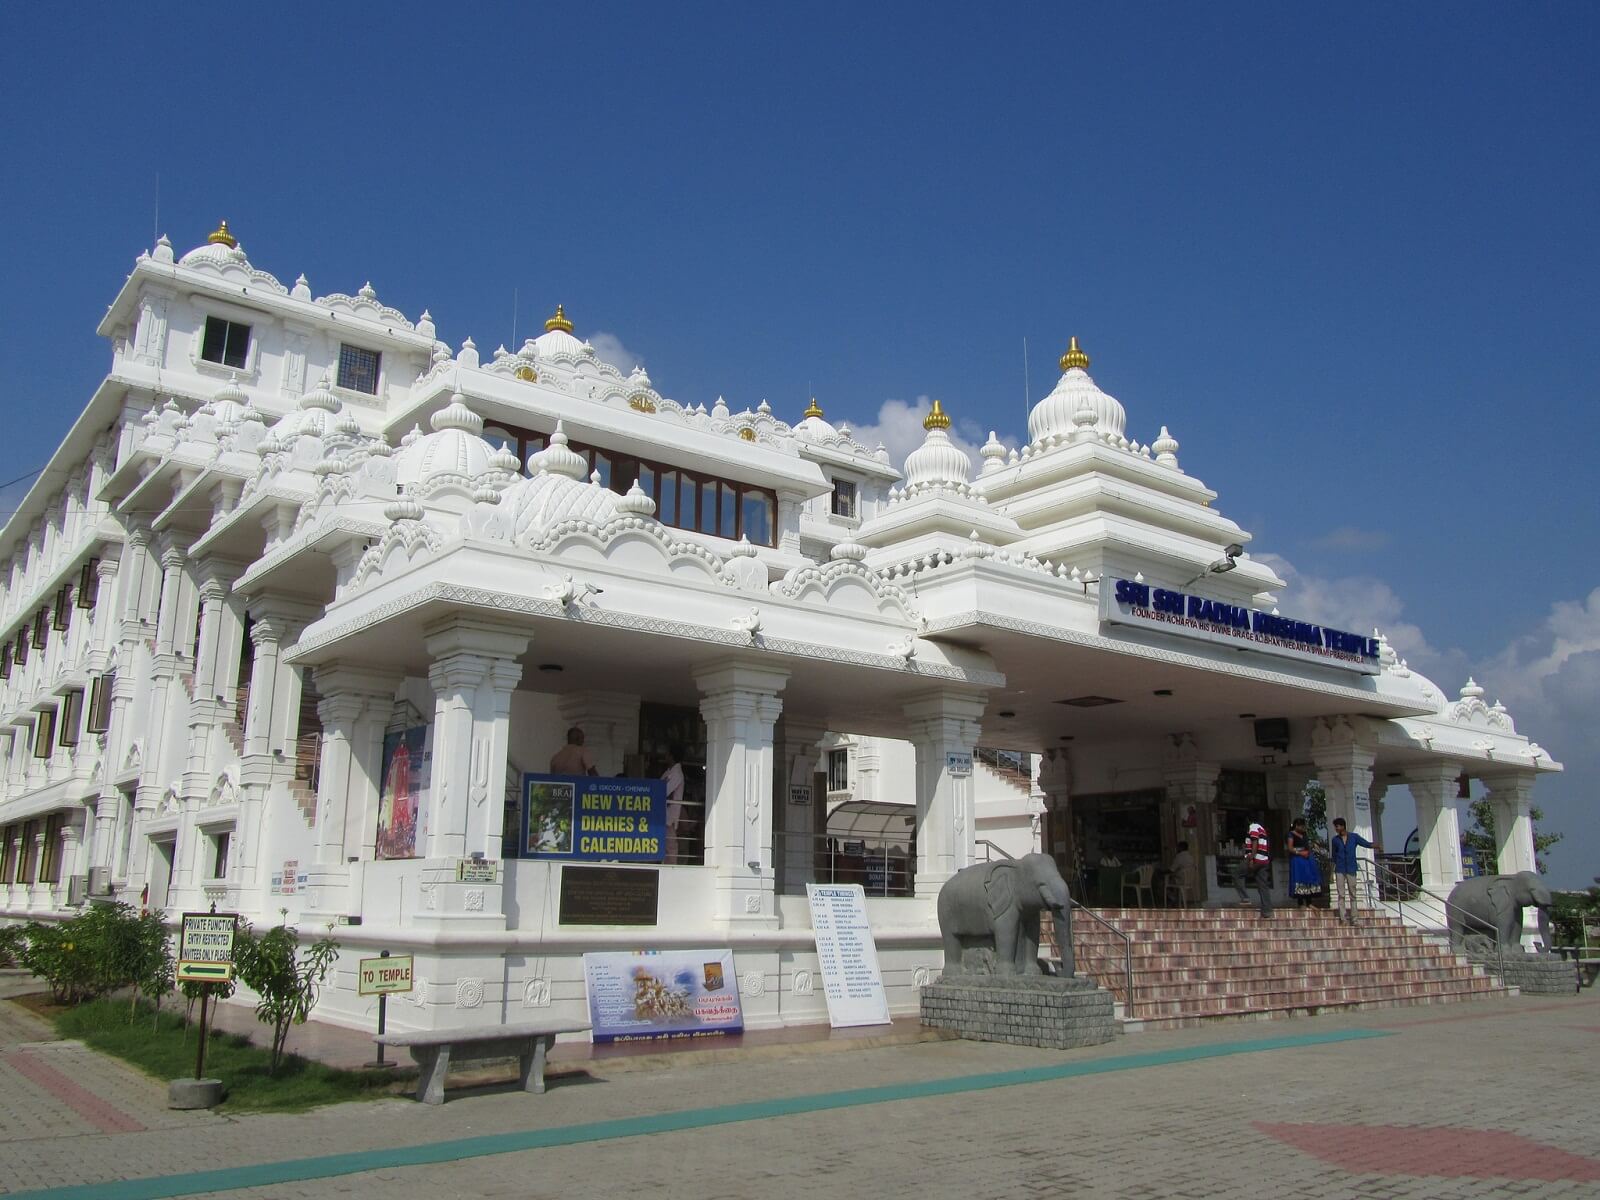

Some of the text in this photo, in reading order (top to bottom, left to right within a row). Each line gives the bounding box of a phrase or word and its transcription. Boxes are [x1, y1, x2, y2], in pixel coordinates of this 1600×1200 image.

[1115, 580, 1149, 607] SRI
[1152, 588, 1185, 615] SRI
[1188, 595, 1250, 630] RADHA
[1321, 627, 1380, 658] TEMPLE
[1132, 607, 1165, 622] FOUNDER
[1166, 615, 1198, 629] ACHARYA
[1199, 623, 1210, 632] HIS
[1211, 625, 1231, 636] DIVINE
[1232, 629, 1253, 641] GRACE
[1311, 646, 1329, 657] SWAMI
[1329, 650, 1365, 665] PRABHUPADA
[598, 784, 621, 792] ISKCON
[625, 785, 650, 793] CHENNAI
[581, 793, 651, 812] NEW YEAR
[581, 815, 649, 833] DIARIES &
[580, 836, 658, 854] CALENDARS
[185, 918, 235, 931] PRIVATE FUNCTION
[188, 933, 229, 946] ENTRY RESTRICTED
[202, 948, 215, 960] ONLY
[214, 949, 231, 961] PLEASE
[363, 968, 410, 984] TO TEMPLE
